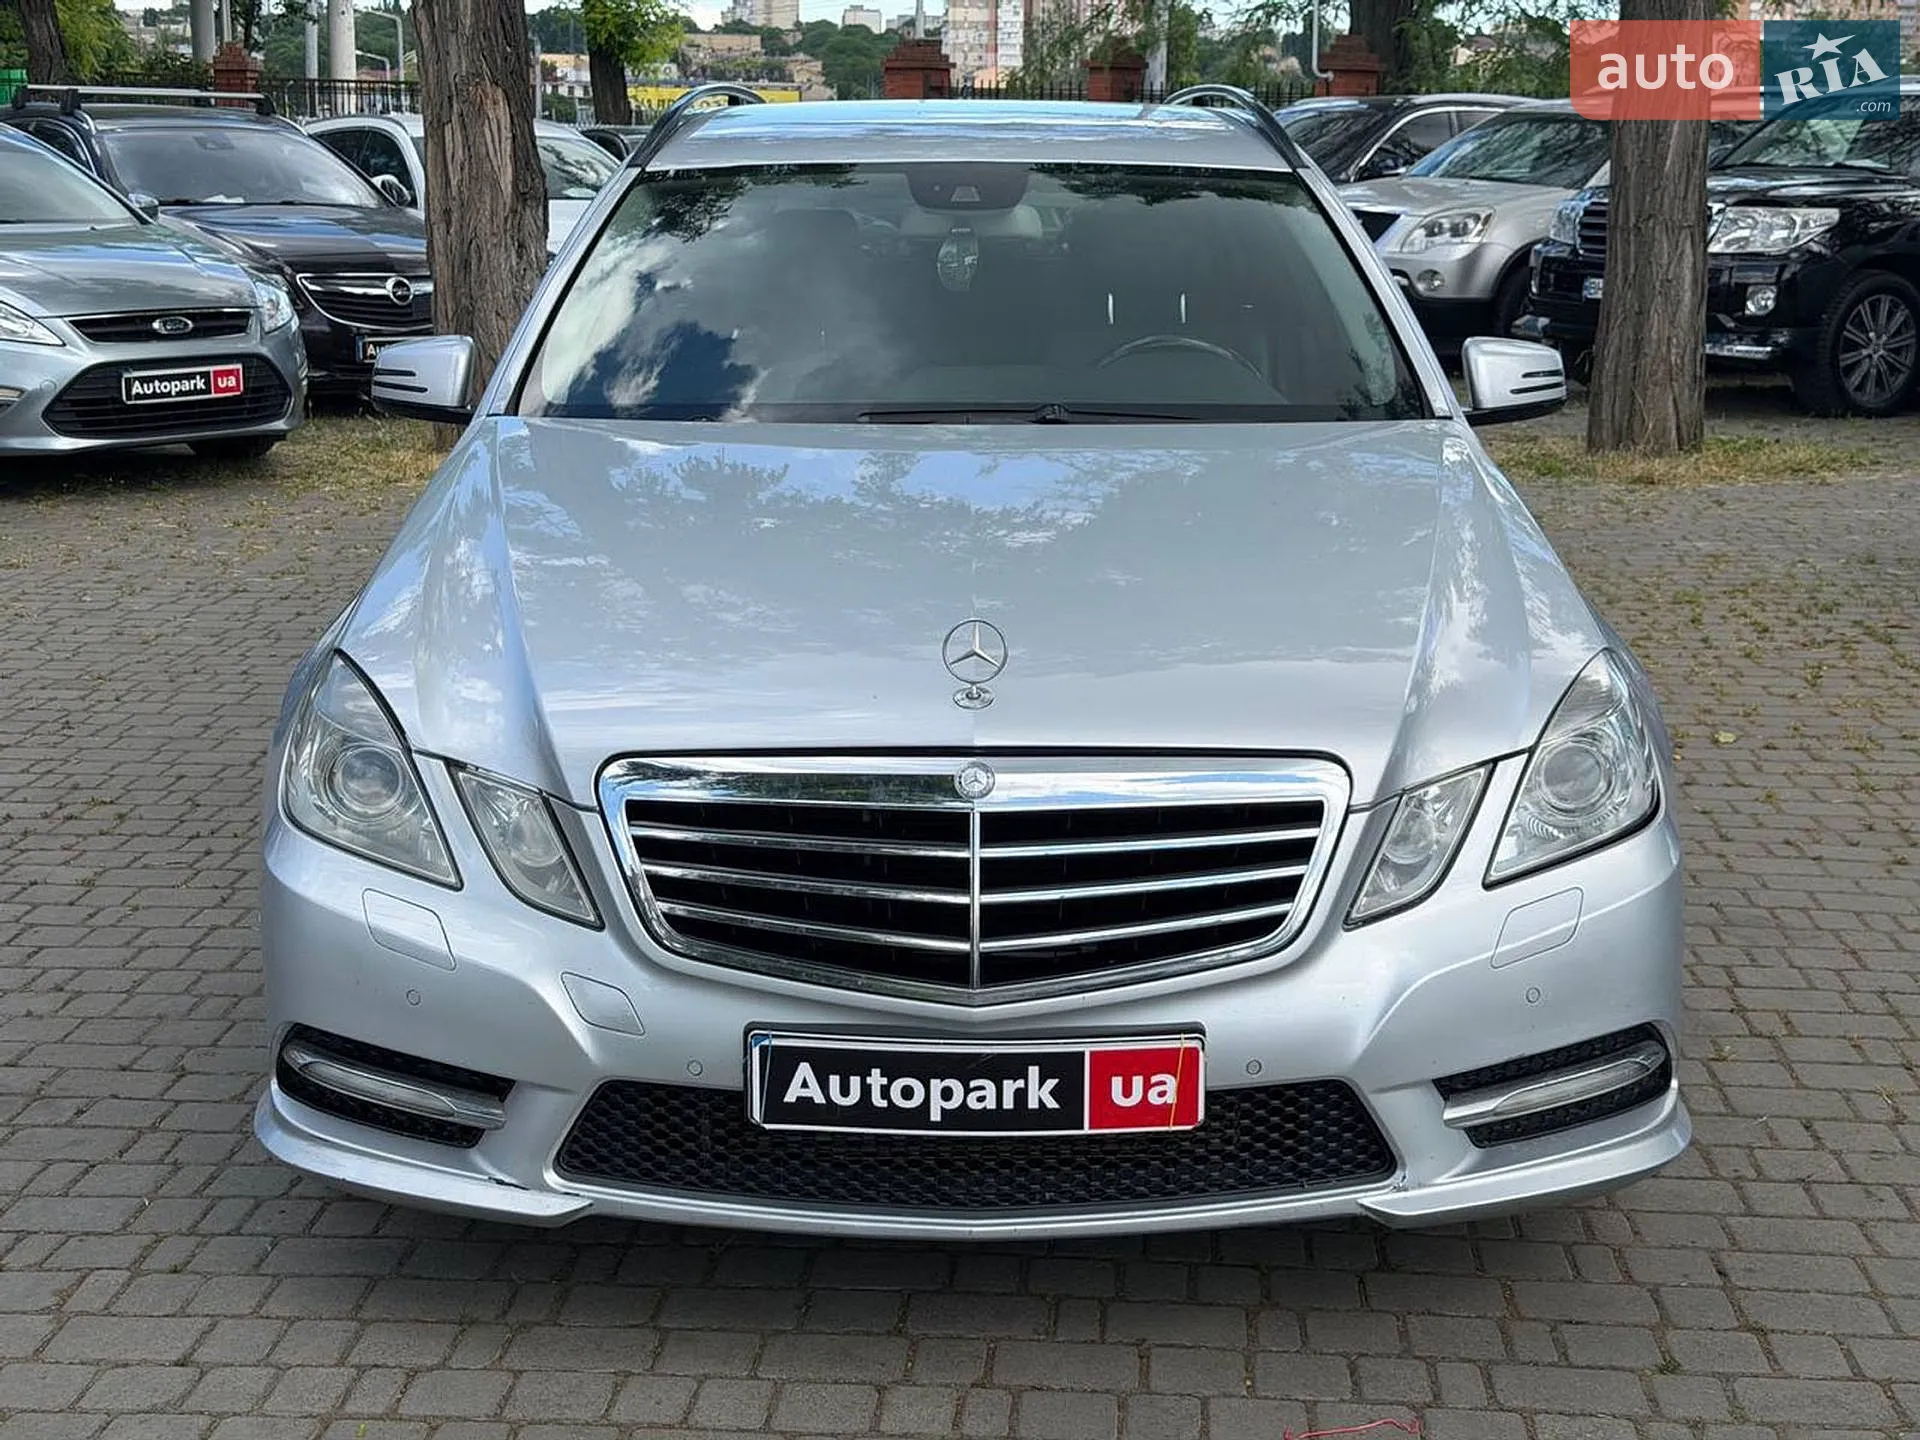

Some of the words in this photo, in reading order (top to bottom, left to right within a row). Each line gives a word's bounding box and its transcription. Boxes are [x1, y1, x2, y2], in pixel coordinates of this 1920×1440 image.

[132, 375, 206, 396] Autopark
[217, 376, 237, 388] ua
[783, 1063, 1061, 1122] Autopark
[1110, 1073, 1177, 1106] ua
